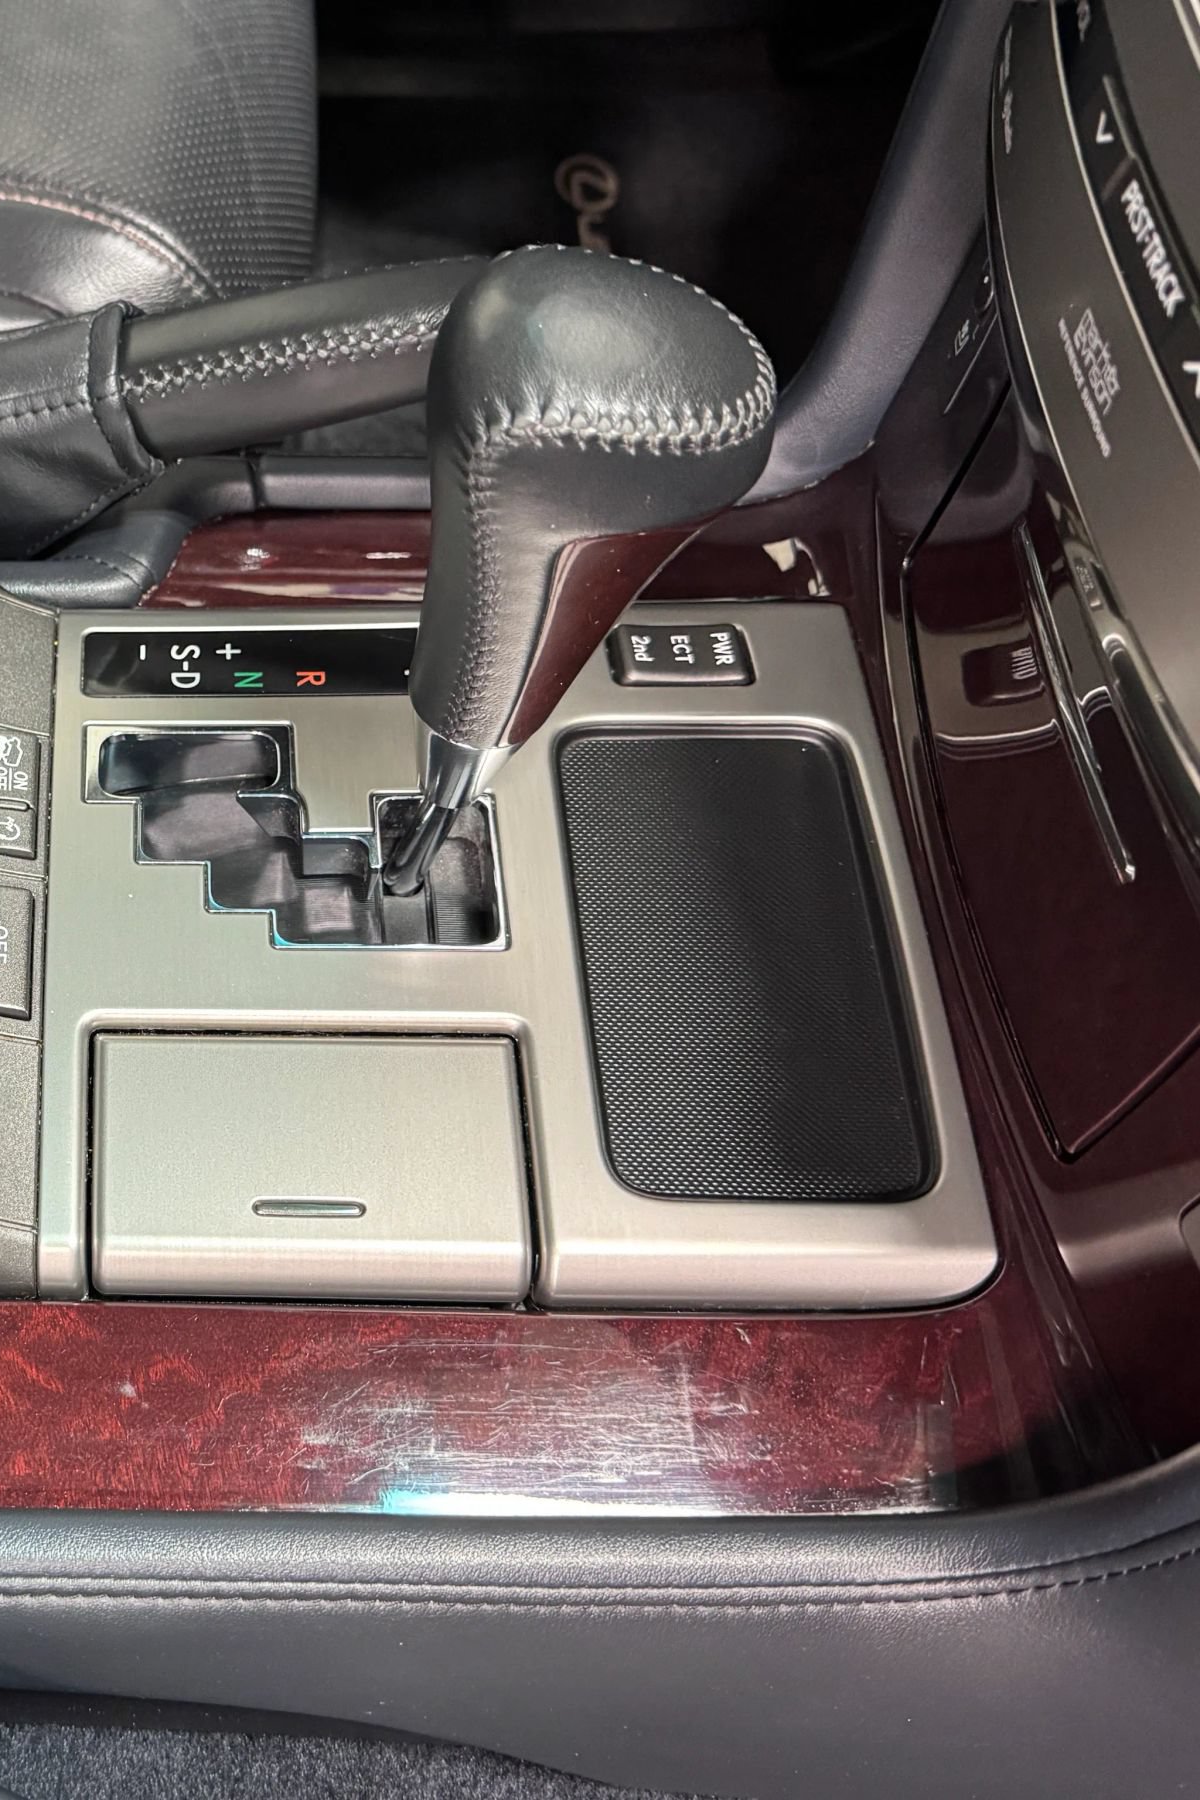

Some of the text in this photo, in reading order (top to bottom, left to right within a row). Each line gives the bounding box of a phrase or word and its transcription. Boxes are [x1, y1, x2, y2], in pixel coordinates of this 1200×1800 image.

[631, 635, 655, 662] 2nd
[670, 634, 695, 664] ECT
[710, 632, 735, 665] PWR
[234, 672, 263, 687] N
[296, 671, 325, 686] R
[13, 771, 28, 790] ON
